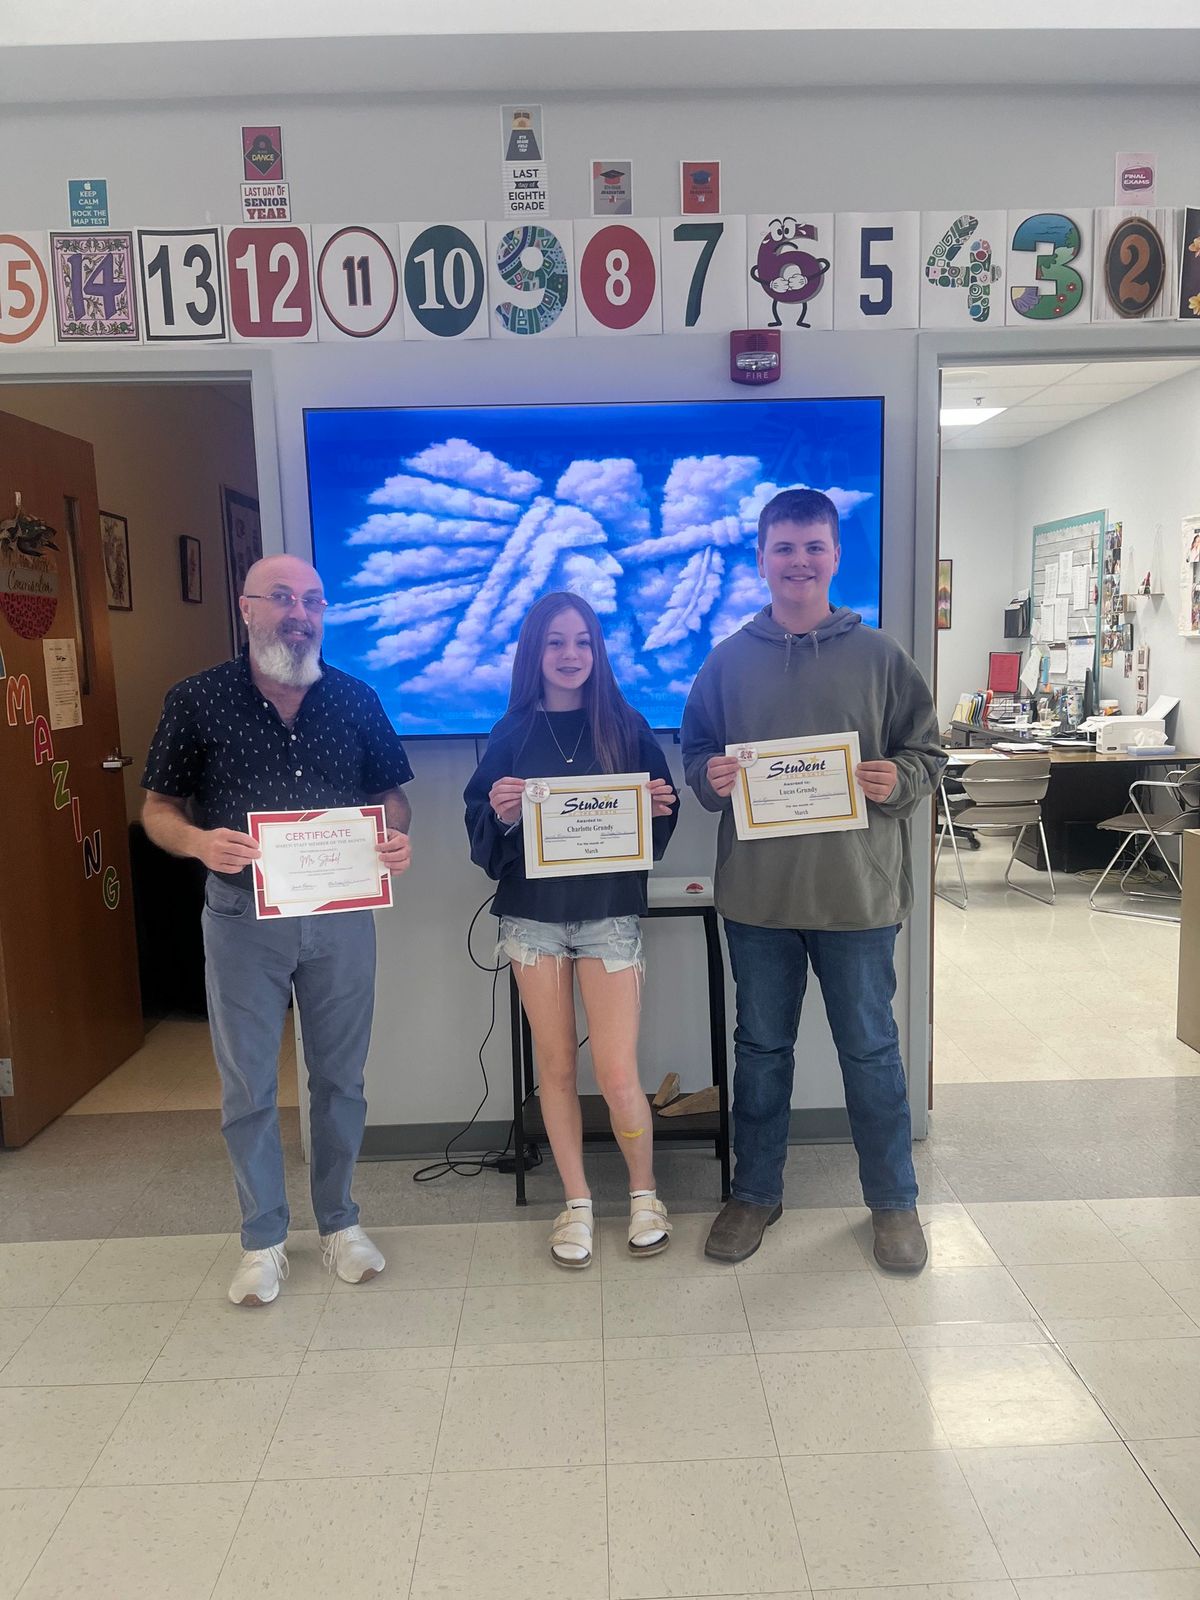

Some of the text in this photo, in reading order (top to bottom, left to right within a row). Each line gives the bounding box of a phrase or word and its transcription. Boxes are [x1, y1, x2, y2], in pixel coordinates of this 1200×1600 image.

[80, 190, 97, 198] KEEP
[244, 186, 286, 196] LAST DAY OF
[508, 191, 546, 201] EIGHTH
[512, 169, 540, 179] LAST
[244, 198, 288, 207] SENIOR
[246, 207, 287, 220] YEAR
[510, 201, 545, 211] GRADE
[0, 260, 35, 319] 5
[66, 252, 127, 322] 14
[147, 243, 217, 326] 13
[235, 242, 303, 323] 12
[342, 255, 372, 306] 11
[413, 247, 475, 310] 10
[495, 225, 569, 335] 9
[605, 248, 632, 306] 8
[673, 222, 724, 328] 7
[757, 223, 825, 304] 6
[859, 226, 894, 316] 5
[925, 215, 1002, 323] 4
[1010, 212, 1084, 320] 3
[1118, 233, 1151, 304] 2
[745, 371, 769, 380] FIRE
[766, 759, 826, 779] Student
[779, 786, 818, 796] Lucas Grundy
[560, 797, 619, 815] Student
[285, 829, 352, 841] CERTIFICATE
